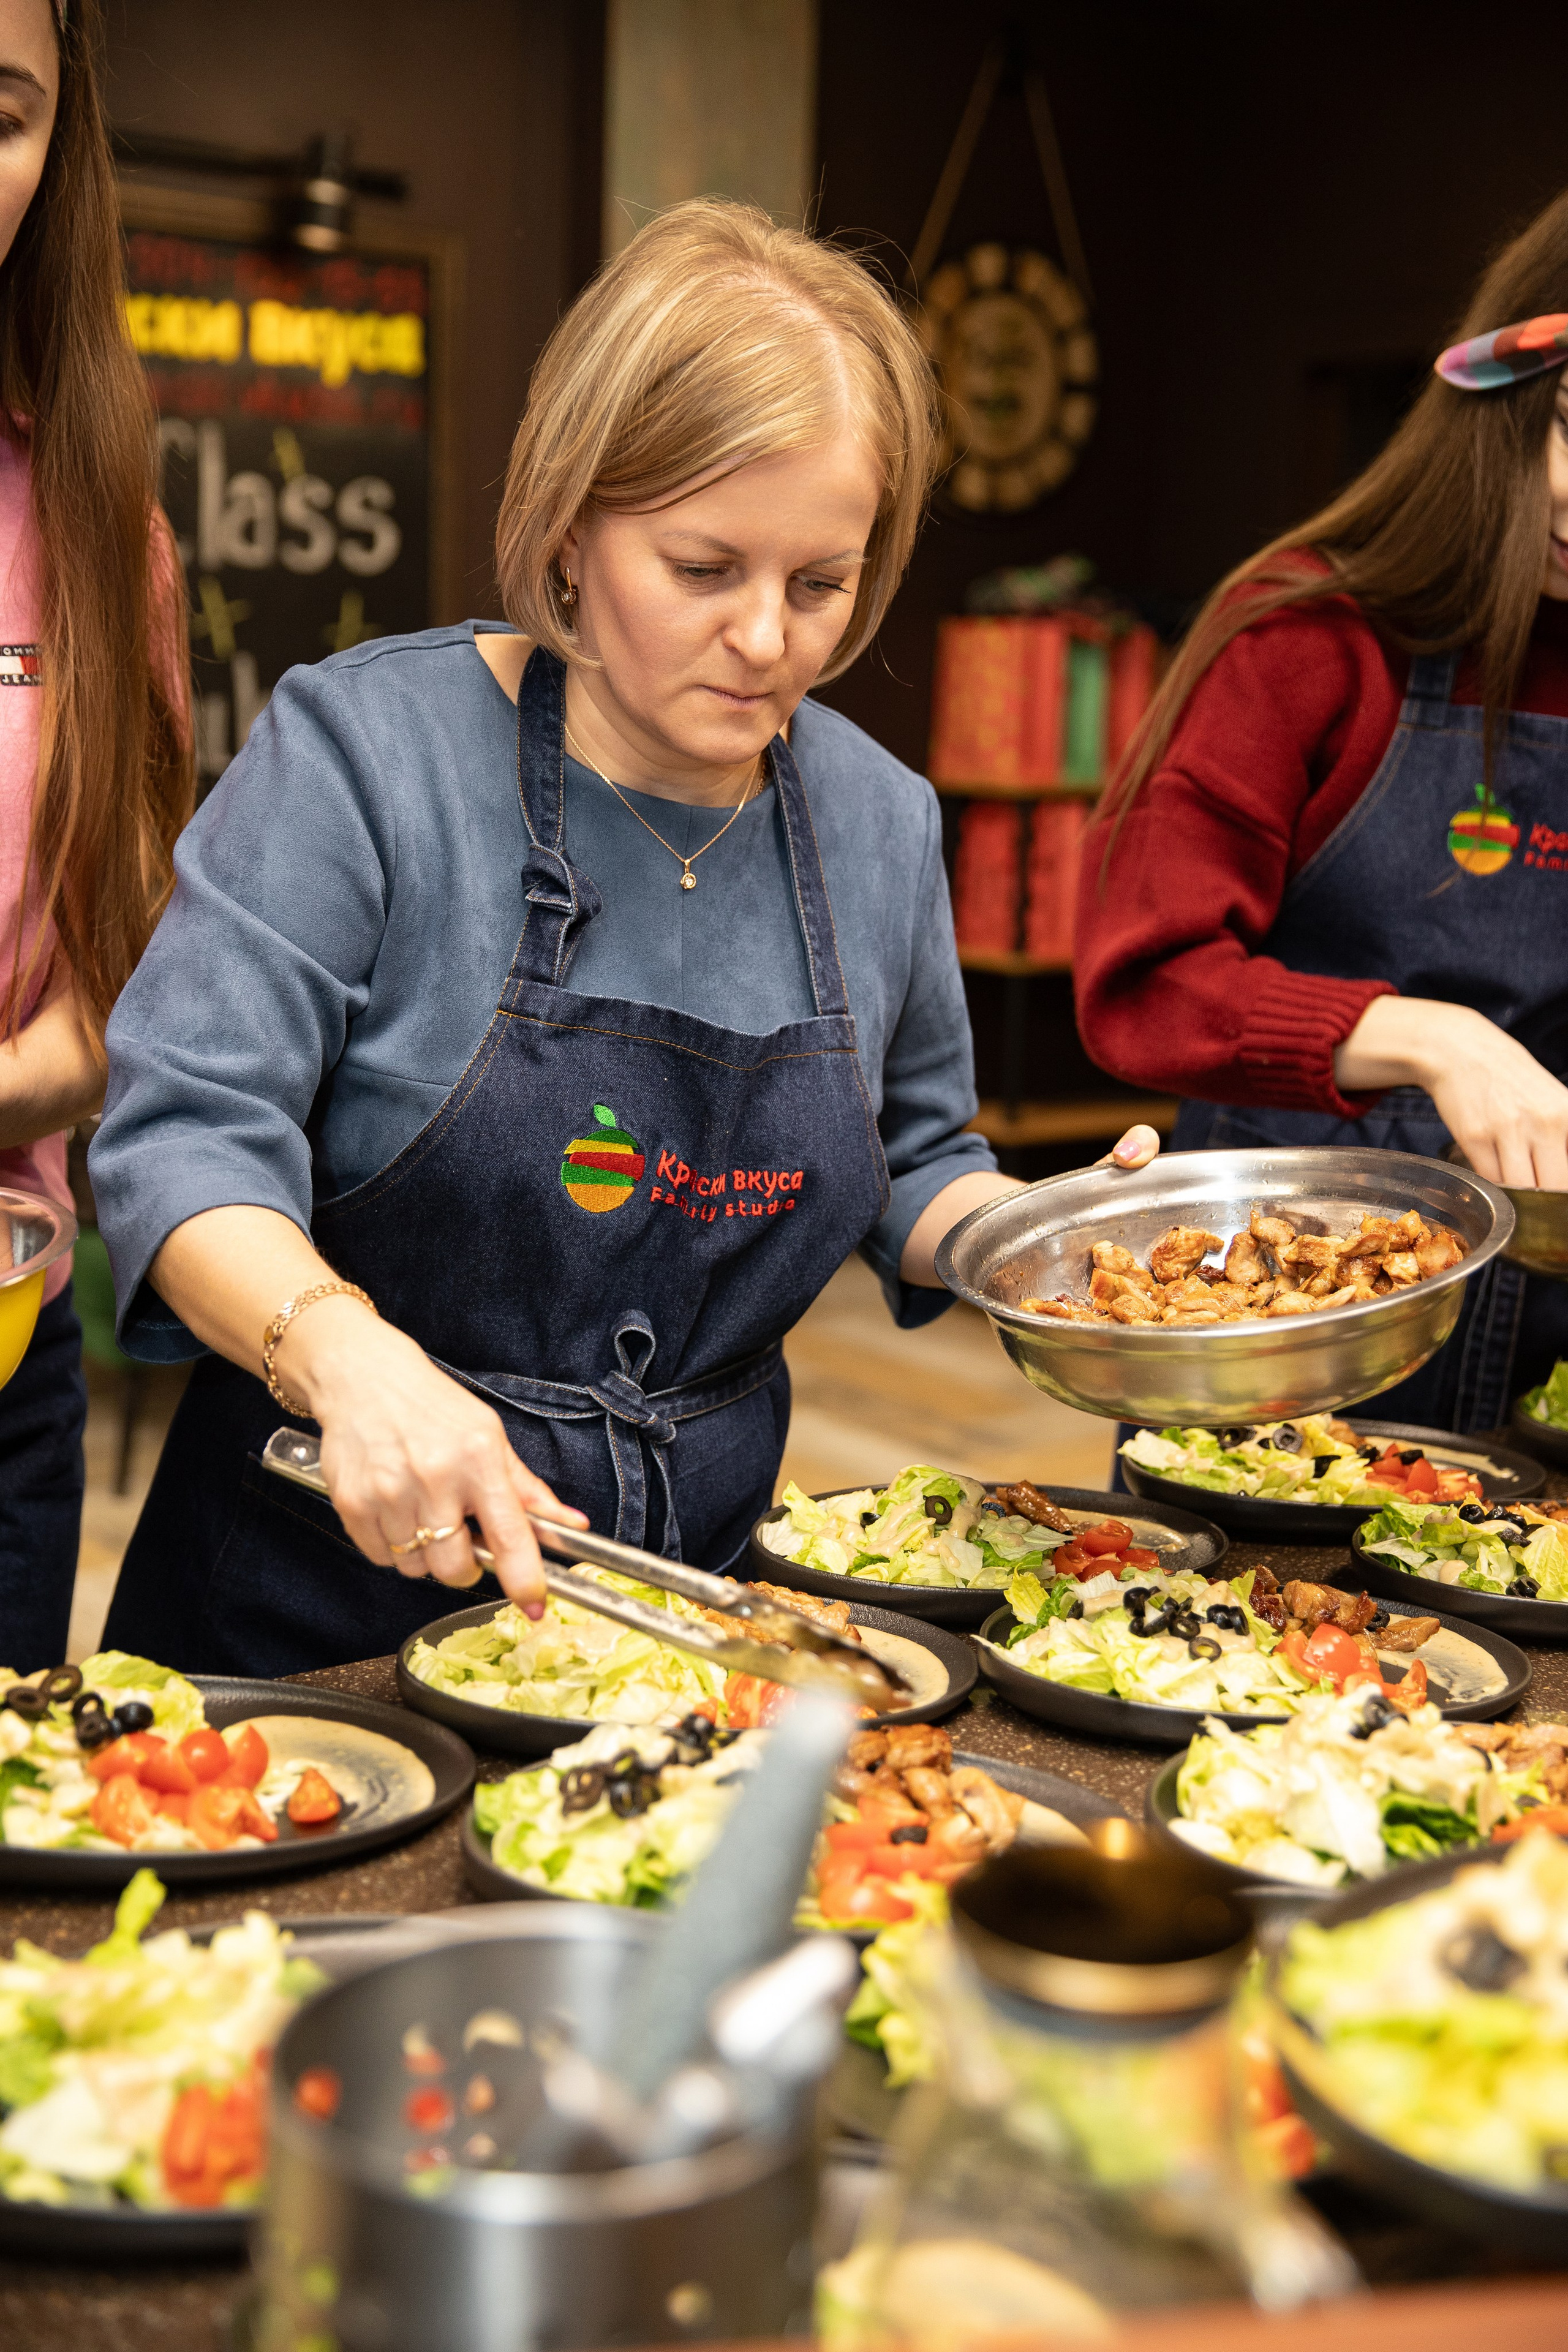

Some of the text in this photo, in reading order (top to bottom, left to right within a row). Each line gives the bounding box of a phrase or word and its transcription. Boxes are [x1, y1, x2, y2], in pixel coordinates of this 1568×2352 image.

[3, 647, 37, 656] OMM
[2, 674, 42, 684] JEAN
[733, 1169, 804, 1199] вкуса
